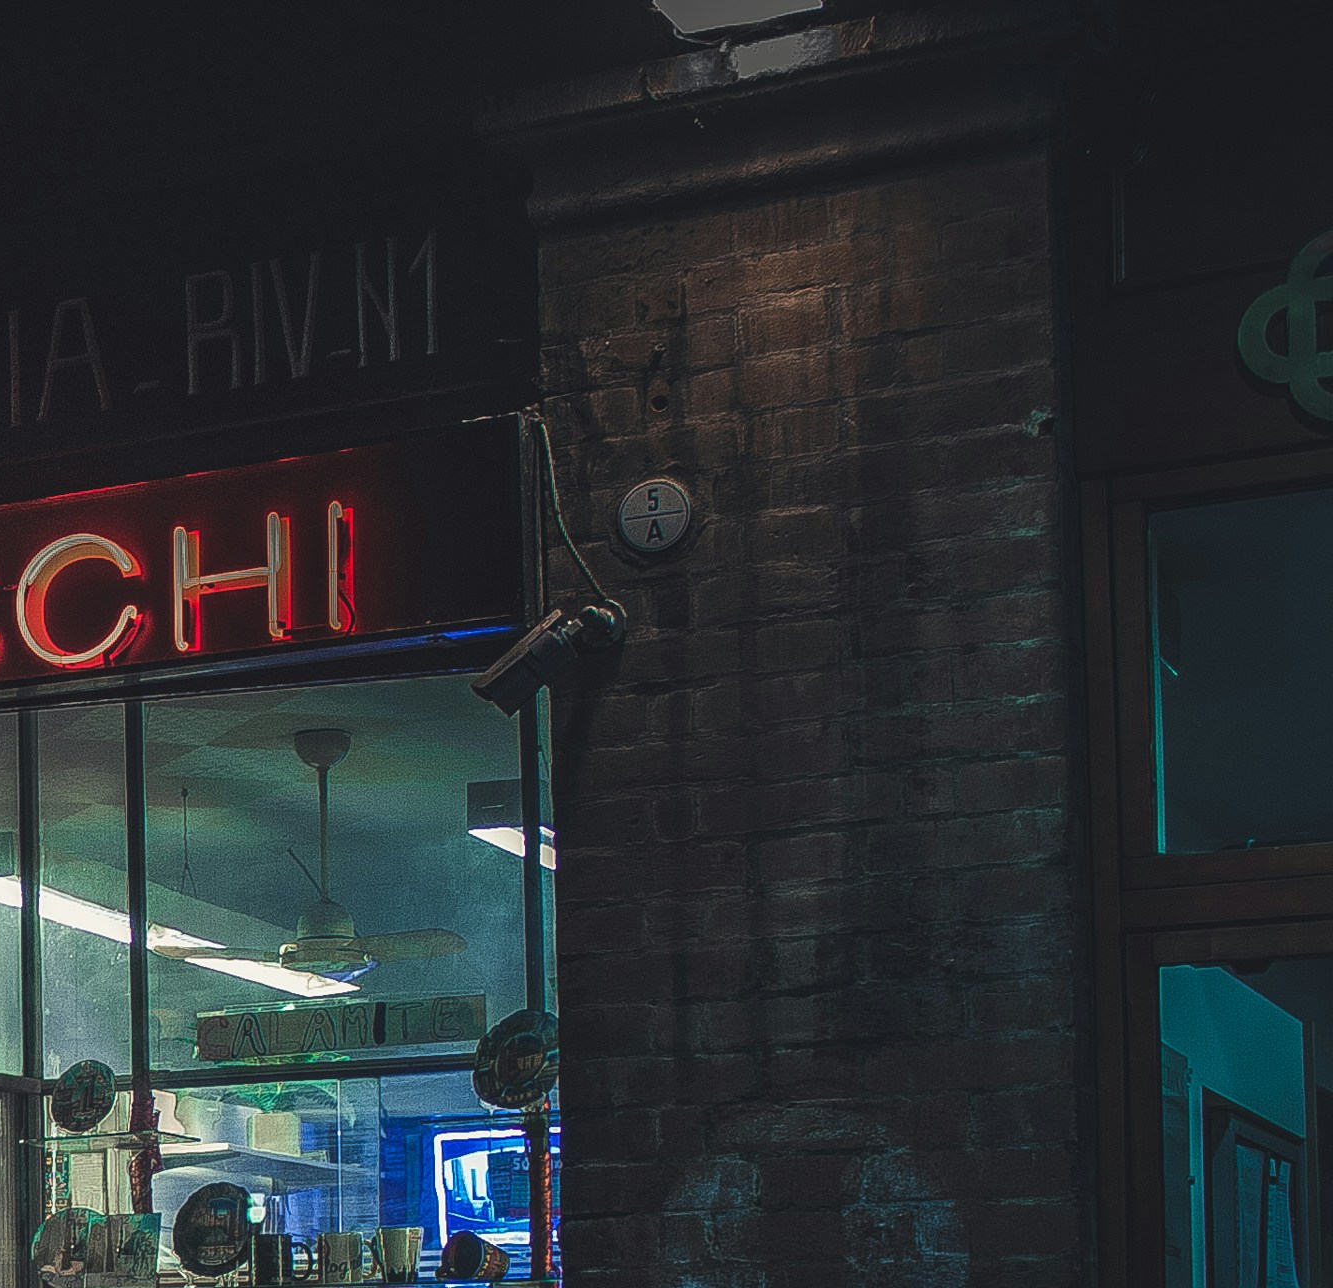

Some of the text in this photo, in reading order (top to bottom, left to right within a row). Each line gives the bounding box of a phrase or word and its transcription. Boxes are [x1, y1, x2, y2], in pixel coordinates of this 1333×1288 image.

[648, 488, 659, 512] 5
[645, 518, 664, 543] A
[197, 998, 463, 1061] CALAMITE
